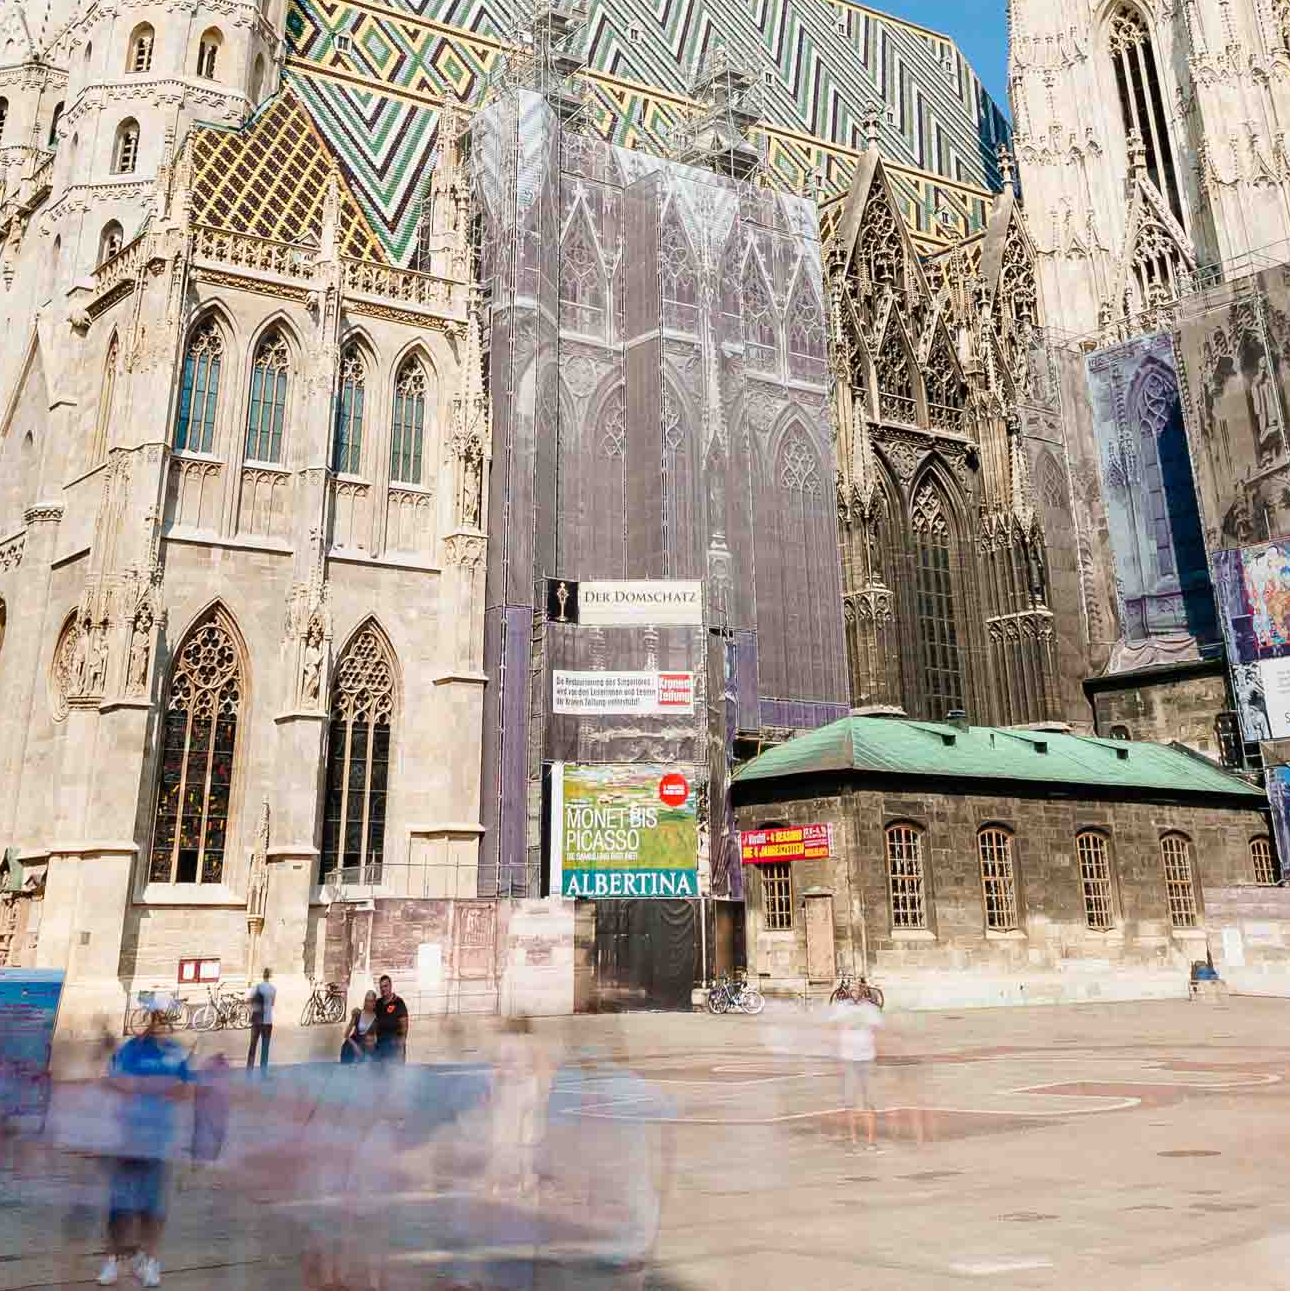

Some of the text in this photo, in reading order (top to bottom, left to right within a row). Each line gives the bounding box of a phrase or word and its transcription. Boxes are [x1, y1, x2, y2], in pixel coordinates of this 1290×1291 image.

[615, 590, 696, 603] DOMSCHATZ
[566, 807, 659, 829] MONET BIS
[566, 830, 640, 852] PICASSO
[566, 872, 693, 896] ALBERTINA
